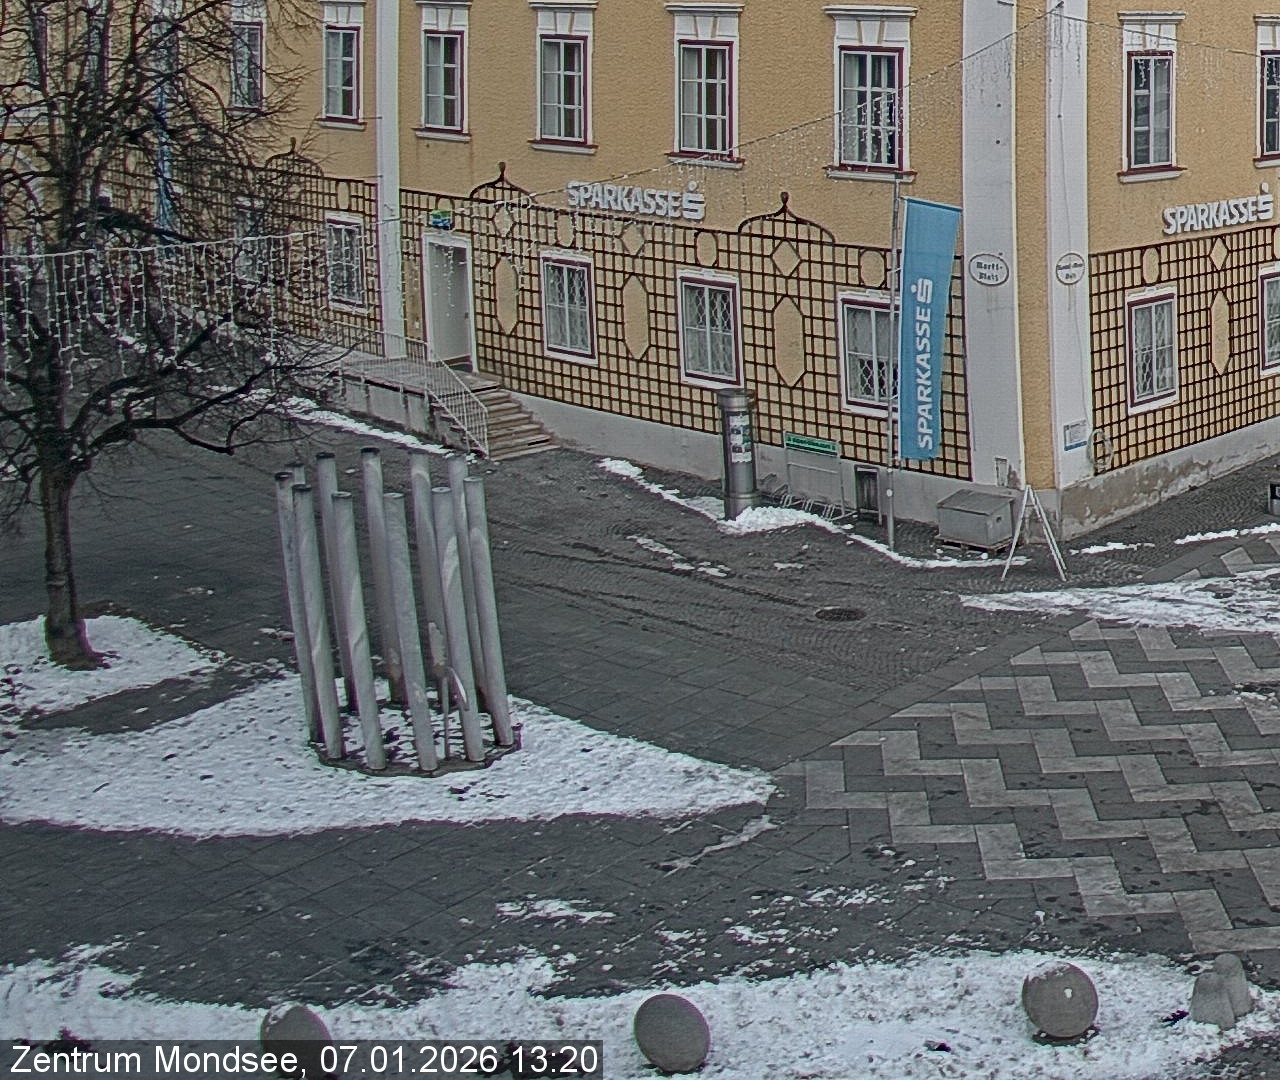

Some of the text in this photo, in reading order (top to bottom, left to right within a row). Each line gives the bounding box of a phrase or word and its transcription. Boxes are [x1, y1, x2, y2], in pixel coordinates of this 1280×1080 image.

[567, 181, 681, 217] SPARKASSE
[1163, 195, 1258, 235] SPARKASSE
[916, 307, 933, 450] SPARKASSE
